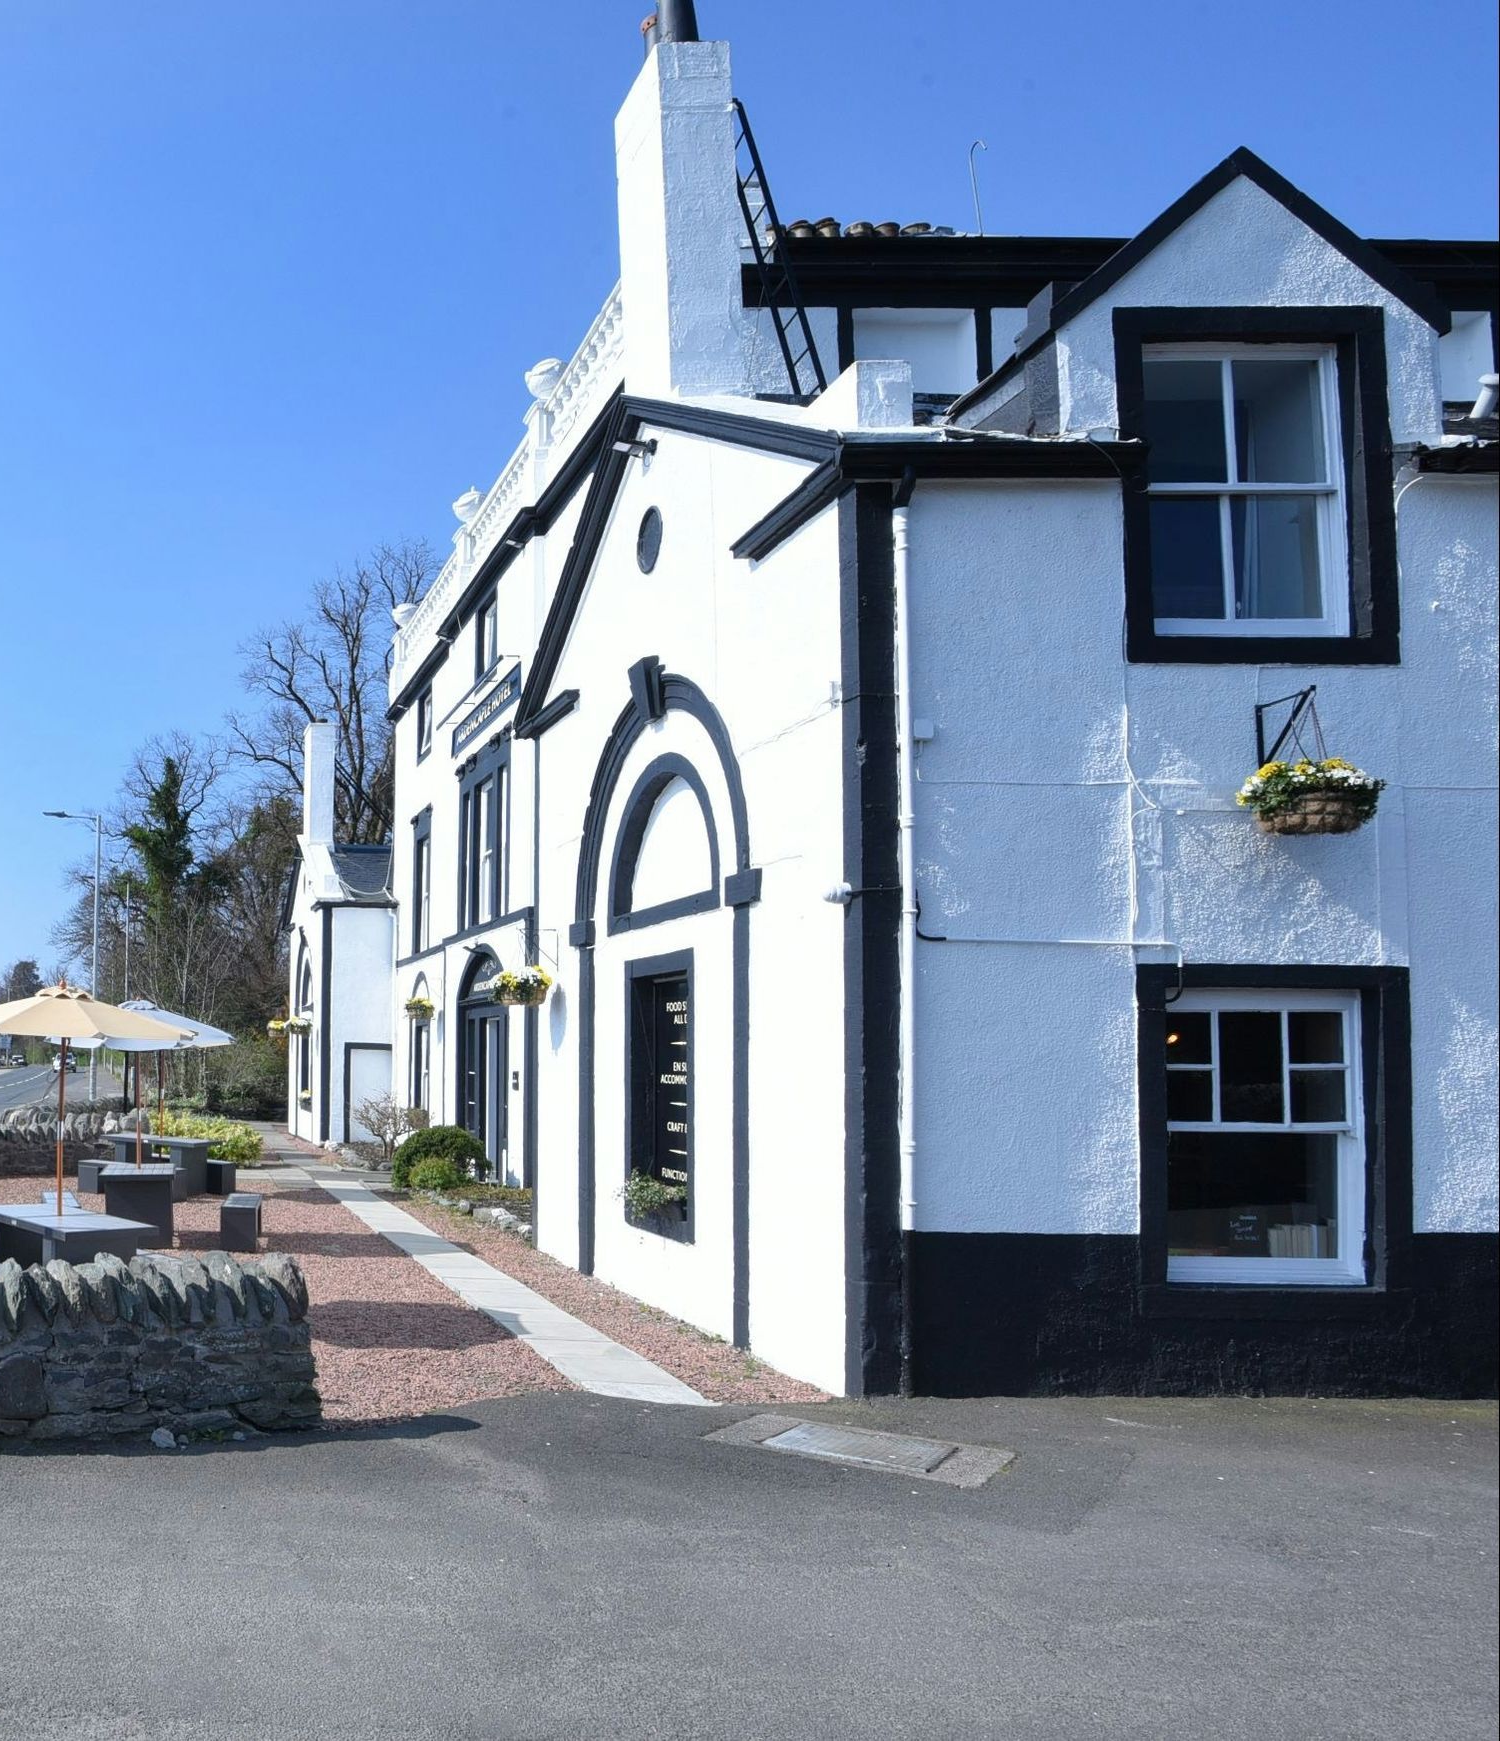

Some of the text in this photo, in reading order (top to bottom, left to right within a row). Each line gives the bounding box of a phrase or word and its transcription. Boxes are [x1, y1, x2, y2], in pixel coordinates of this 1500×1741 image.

[666, 1001, 682, 1012] FOOD
[673, 1014, 684, 1025] ALL
[673, 1062, 681, 1072] EN
[667, 1121, 684, 1133] CRAFT
